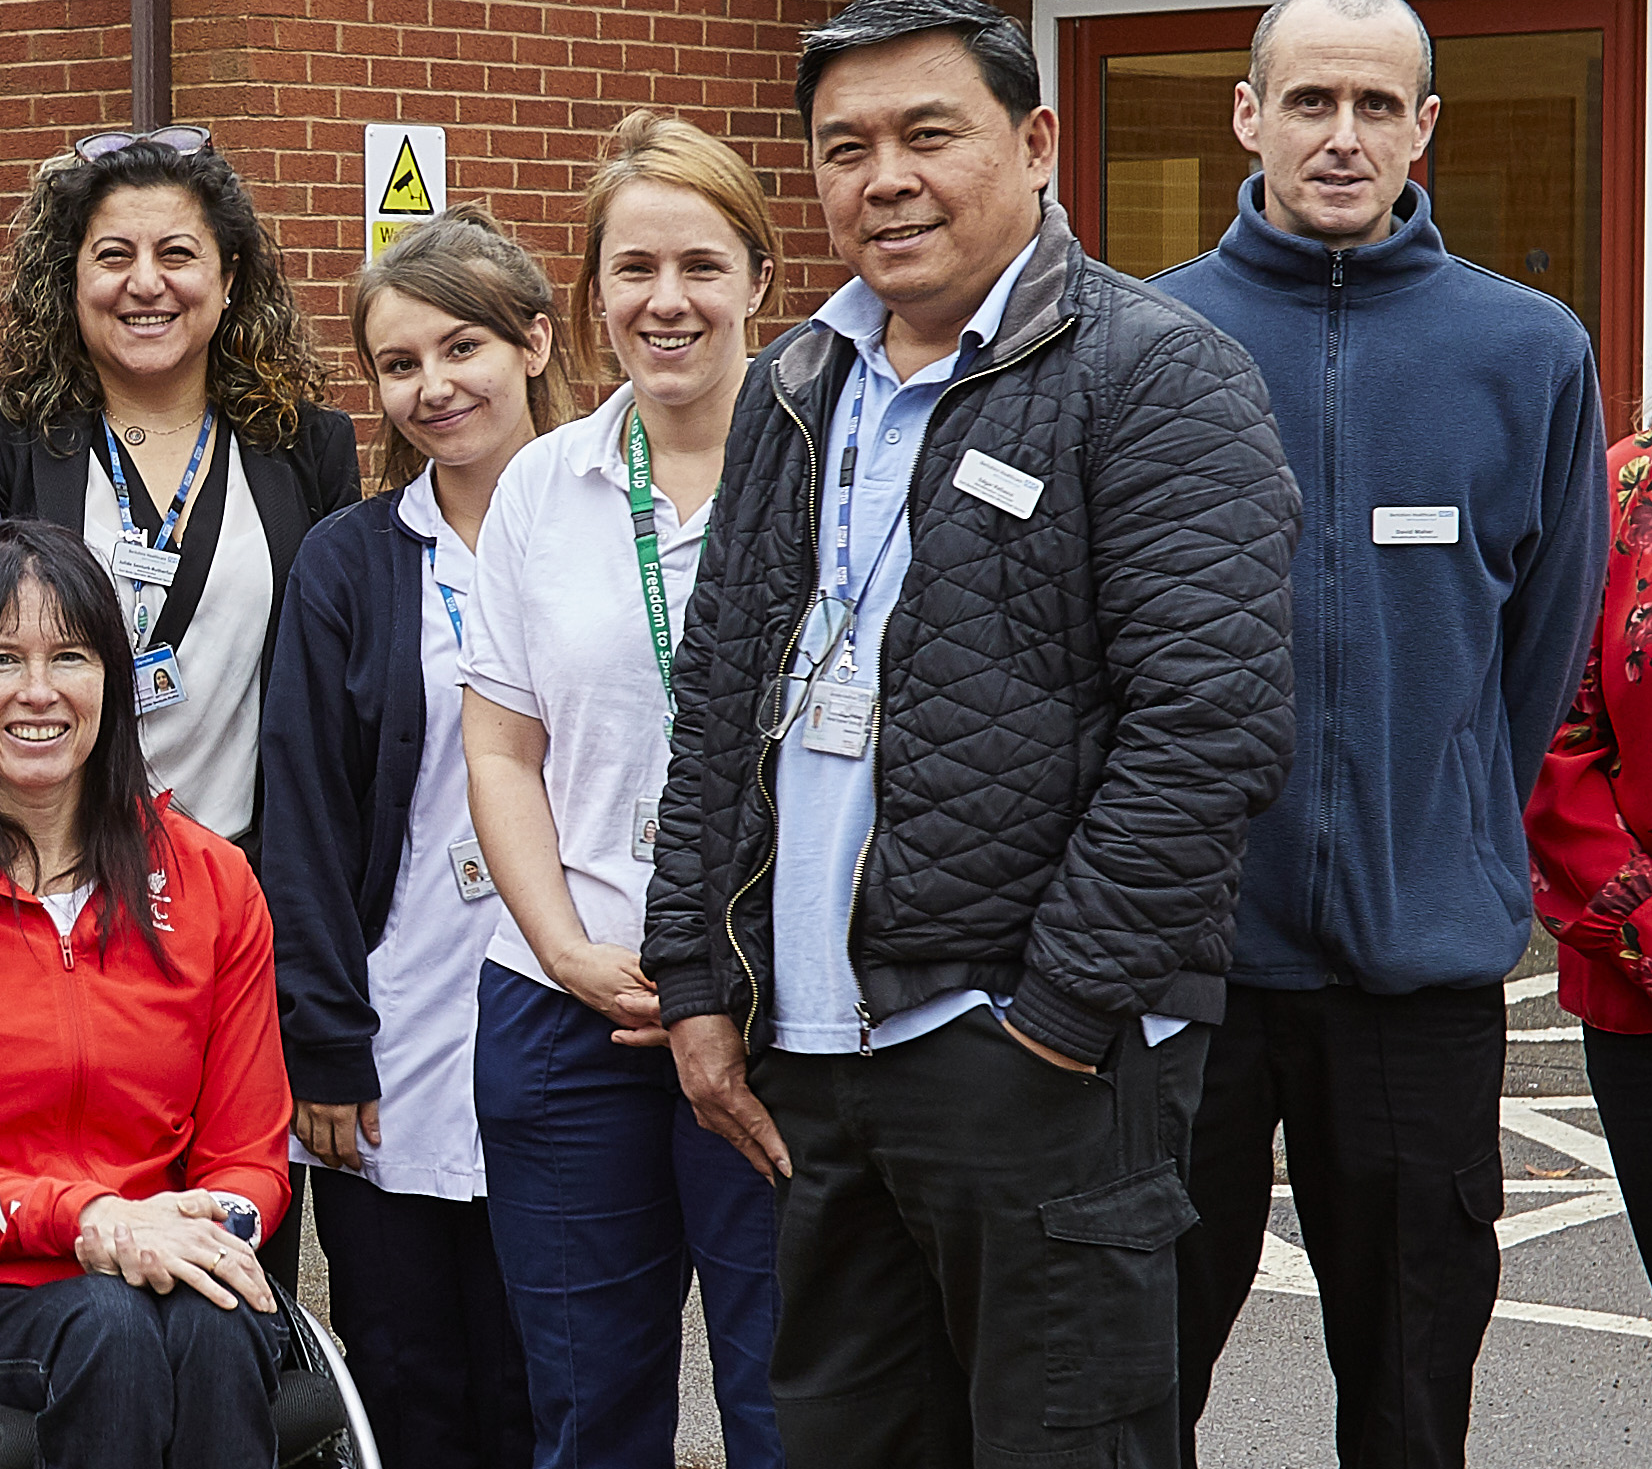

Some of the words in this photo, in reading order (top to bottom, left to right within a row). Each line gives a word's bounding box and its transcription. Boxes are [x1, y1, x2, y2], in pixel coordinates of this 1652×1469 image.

[630, 433, 649, 470] Speak
[631, 470, 649, 488] Up
[644, 562, 666, 627] Freedom
[656, 630, 668, 647] to
